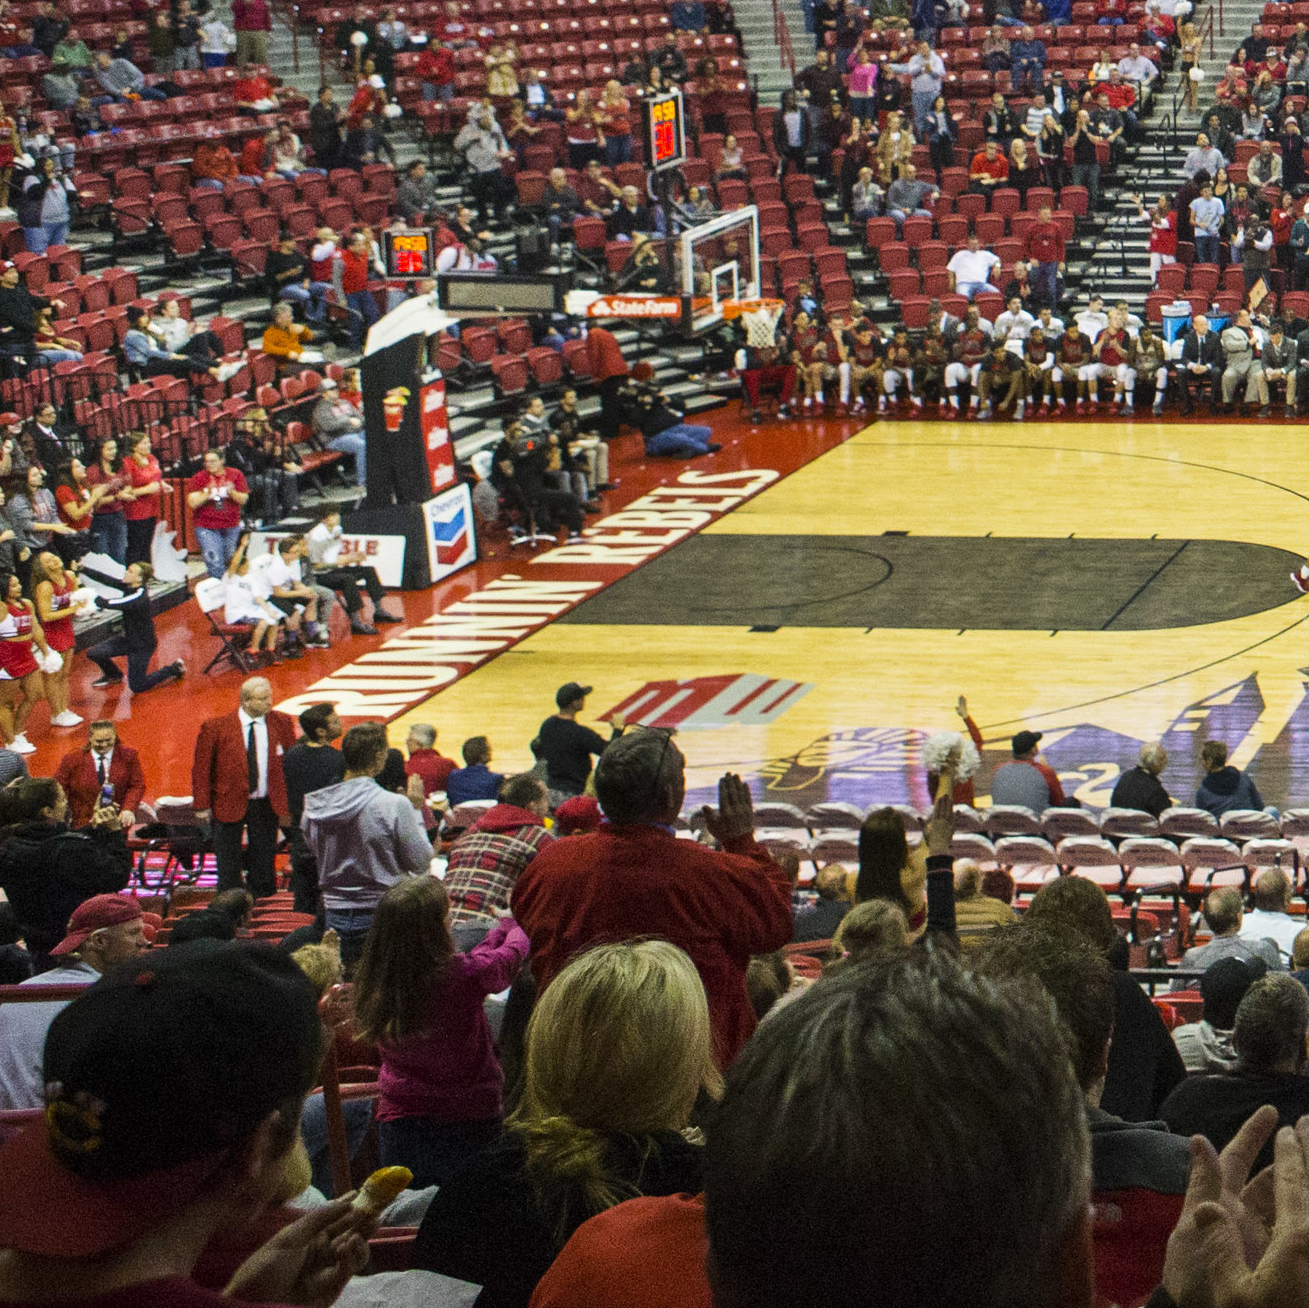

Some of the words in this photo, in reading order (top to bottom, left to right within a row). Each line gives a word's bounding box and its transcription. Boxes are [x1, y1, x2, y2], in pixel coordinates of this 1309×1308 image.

[431, 493, 465, 516] Chevron
[271, 574, 605, 716] RUNNIN'
[529, 468, 781, 565] REBELS
